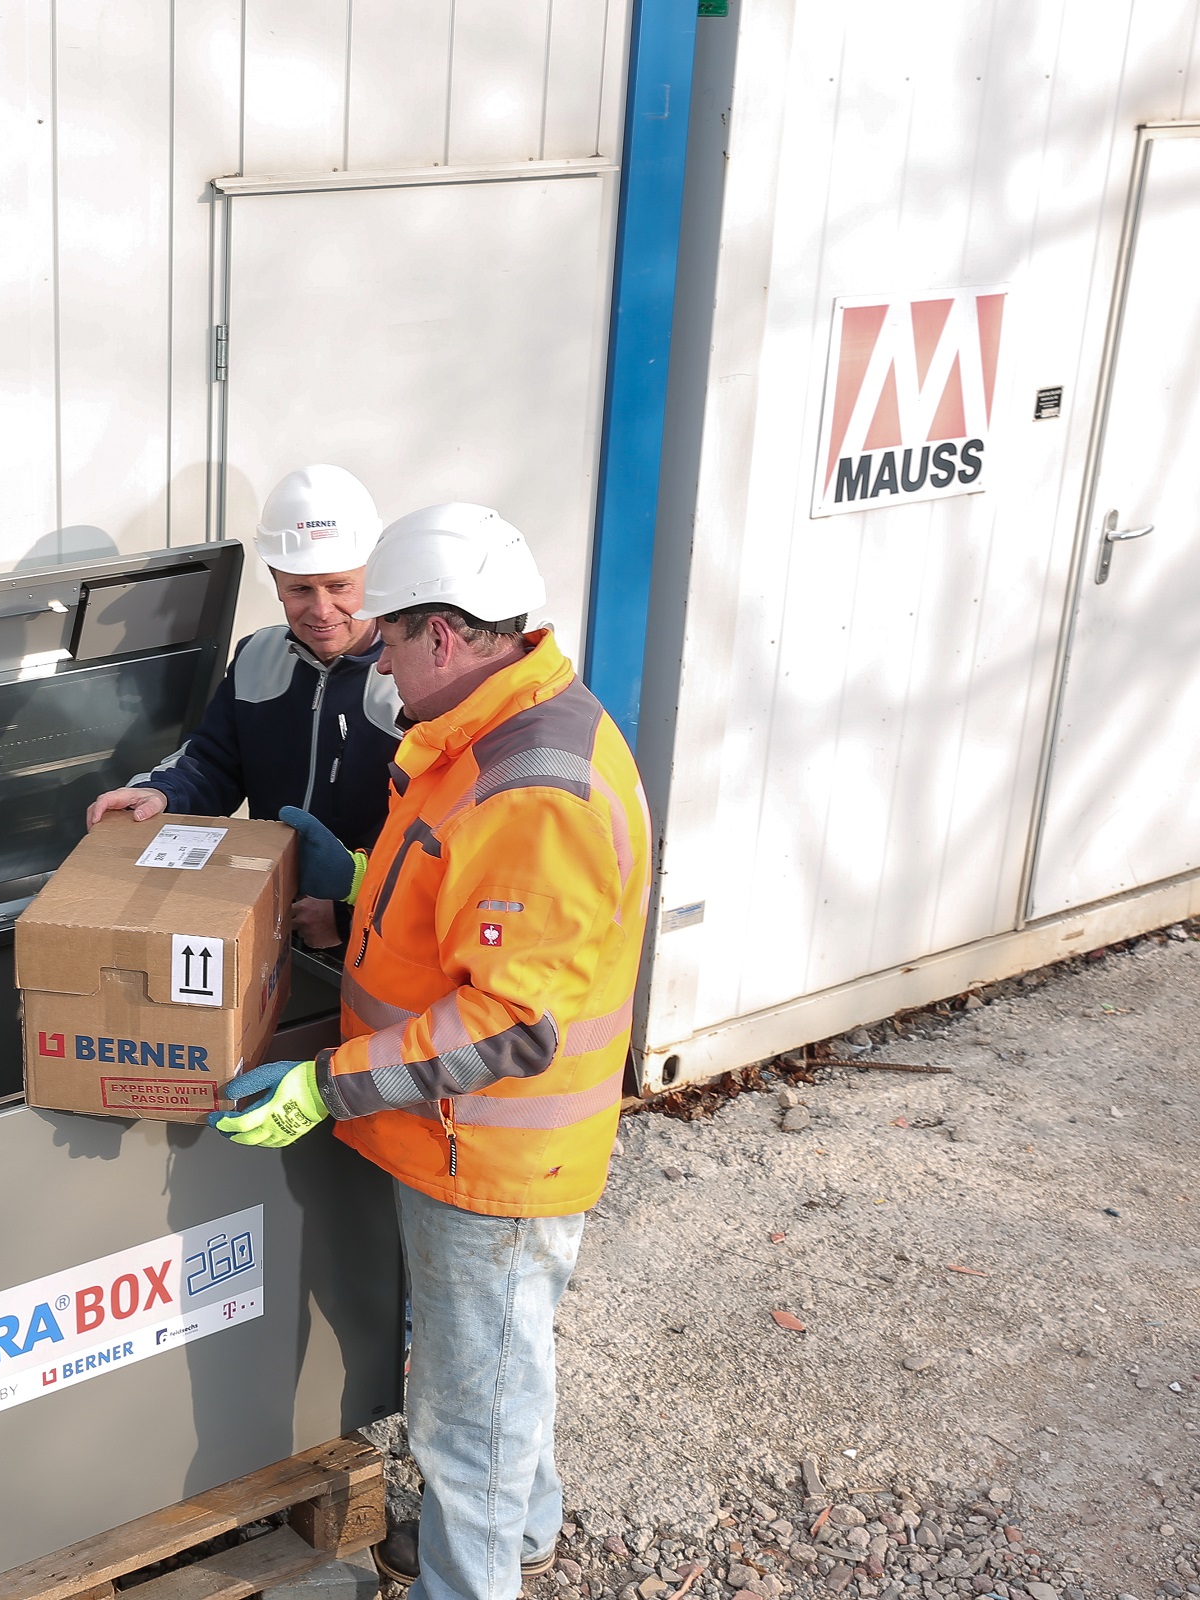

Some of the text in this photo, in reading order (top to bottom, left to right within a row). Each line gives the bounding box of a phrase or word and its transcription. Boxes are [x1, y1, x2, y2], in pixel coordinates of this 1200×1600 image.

[834, 438, 985, 503] MAUSS
[306, 520, 337, 528] BERNER
[75, 1035, 210, 1072] BERNER
[111, 1084, 208, 1096] EXPERTS WITH
[131, 1095, 189, 1105] PASSION
[75, 1259, 173, 1335] BOX
[0, 1384, 19, 1401] BY
[62, 1341, 134, 1379] BERNER
